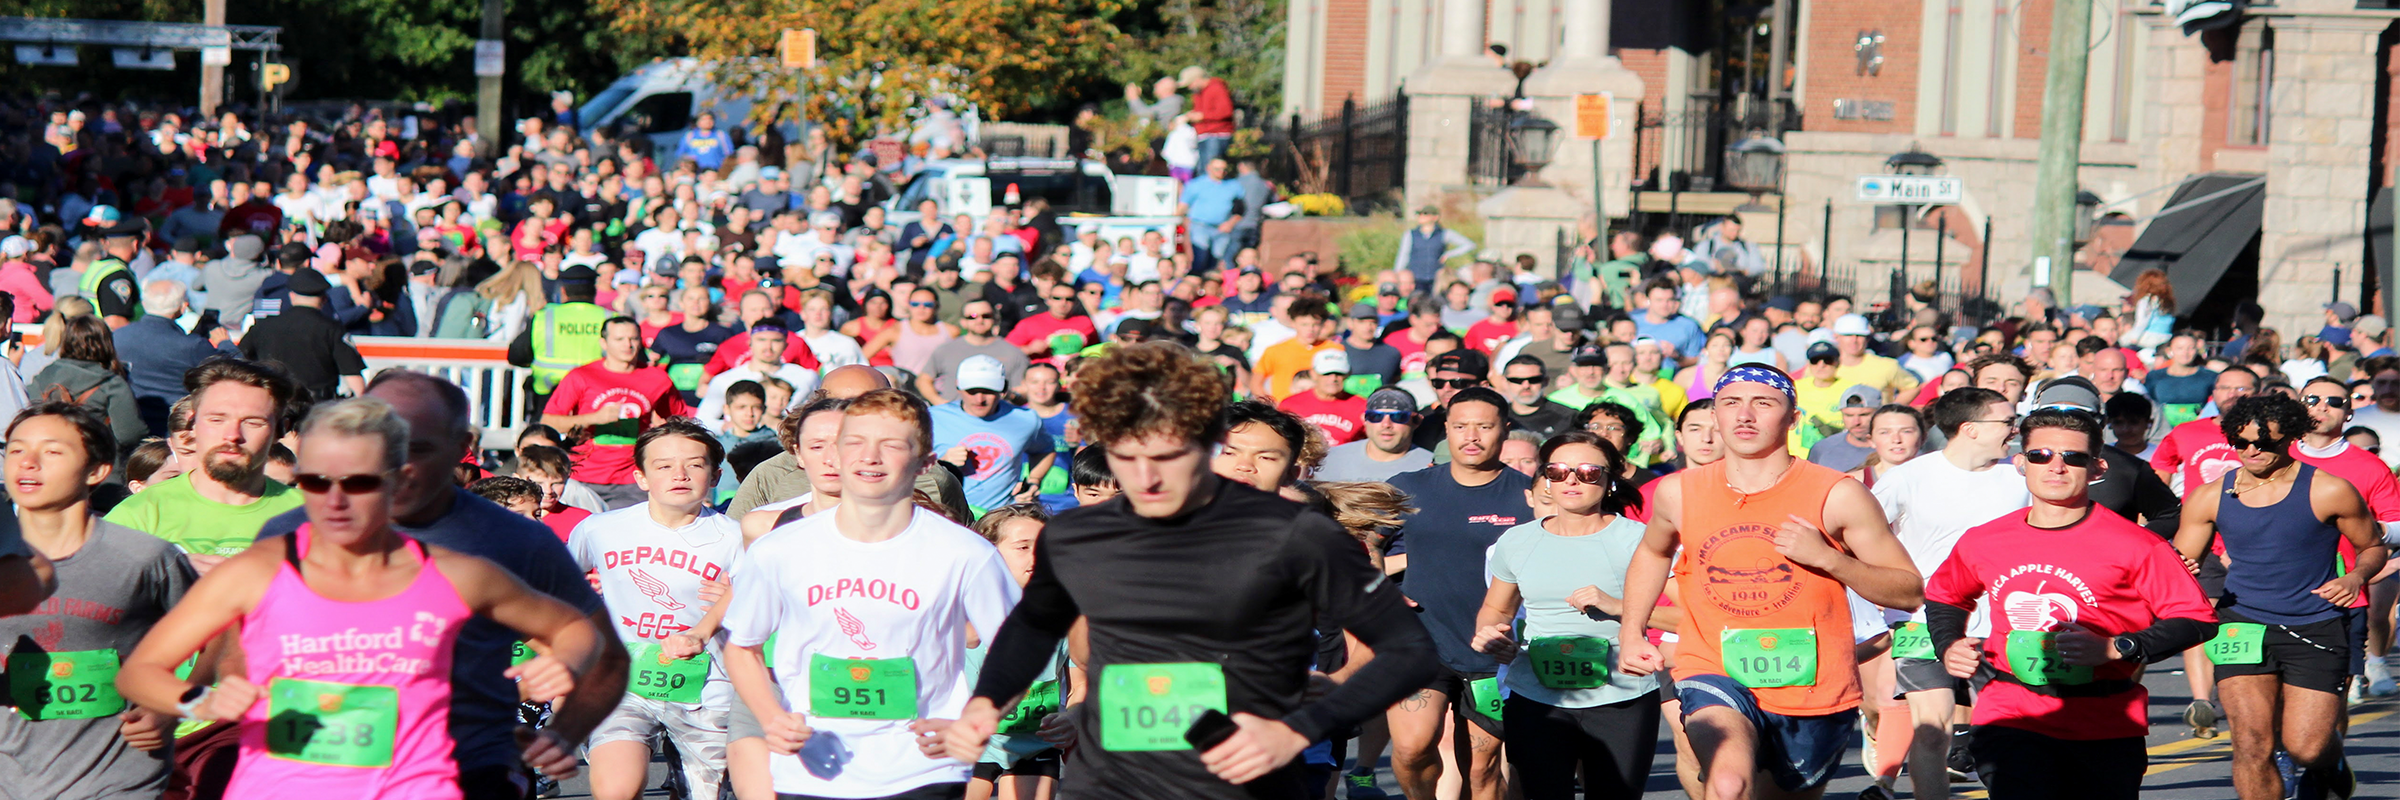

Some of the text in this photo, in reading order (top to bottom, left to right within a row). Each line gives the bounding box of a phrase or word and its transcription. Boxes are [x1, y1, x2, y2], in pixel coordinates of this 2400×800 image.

[264, 63, 290, 92] P
[1891, 181, 1952, 197] Main St
[559, 323, 600, 335] POLICE
[1304, 413, 1354, 432] PAOLO
[1698, 535, 1720, 566] YMCA
[1720, 525, 1761, 538] CAMP
[1762, 527, 1777, 539] SL
[604, 546, 721, 581] DEPAOLO
[2010, 563, 2053, 578] APPLE
[2054, 567, 2099, 608] HARVEST
[1718, 602, 1760, 616] adventure
[1772, 581, 1803, 610] tradition
[1732, 591, 1763, 601] 1949
[64, 597, 124, 625] FARMS
[279, 626, 404, 656] Hartford
[2213, 641, 2250, 655] 1351
[281, 652, 432, 677] HealthCare
[1542, 660, 1594, 677] 1318
[1739, 655, 1802, 674] 1014
[2026, 656, 2072, 673] 724
[637, 669, 686, 689] 530
[35, 684, 98, 705] 602
[834, 686, 886, 706] 951
[285, 718, 375, 748] 1238
